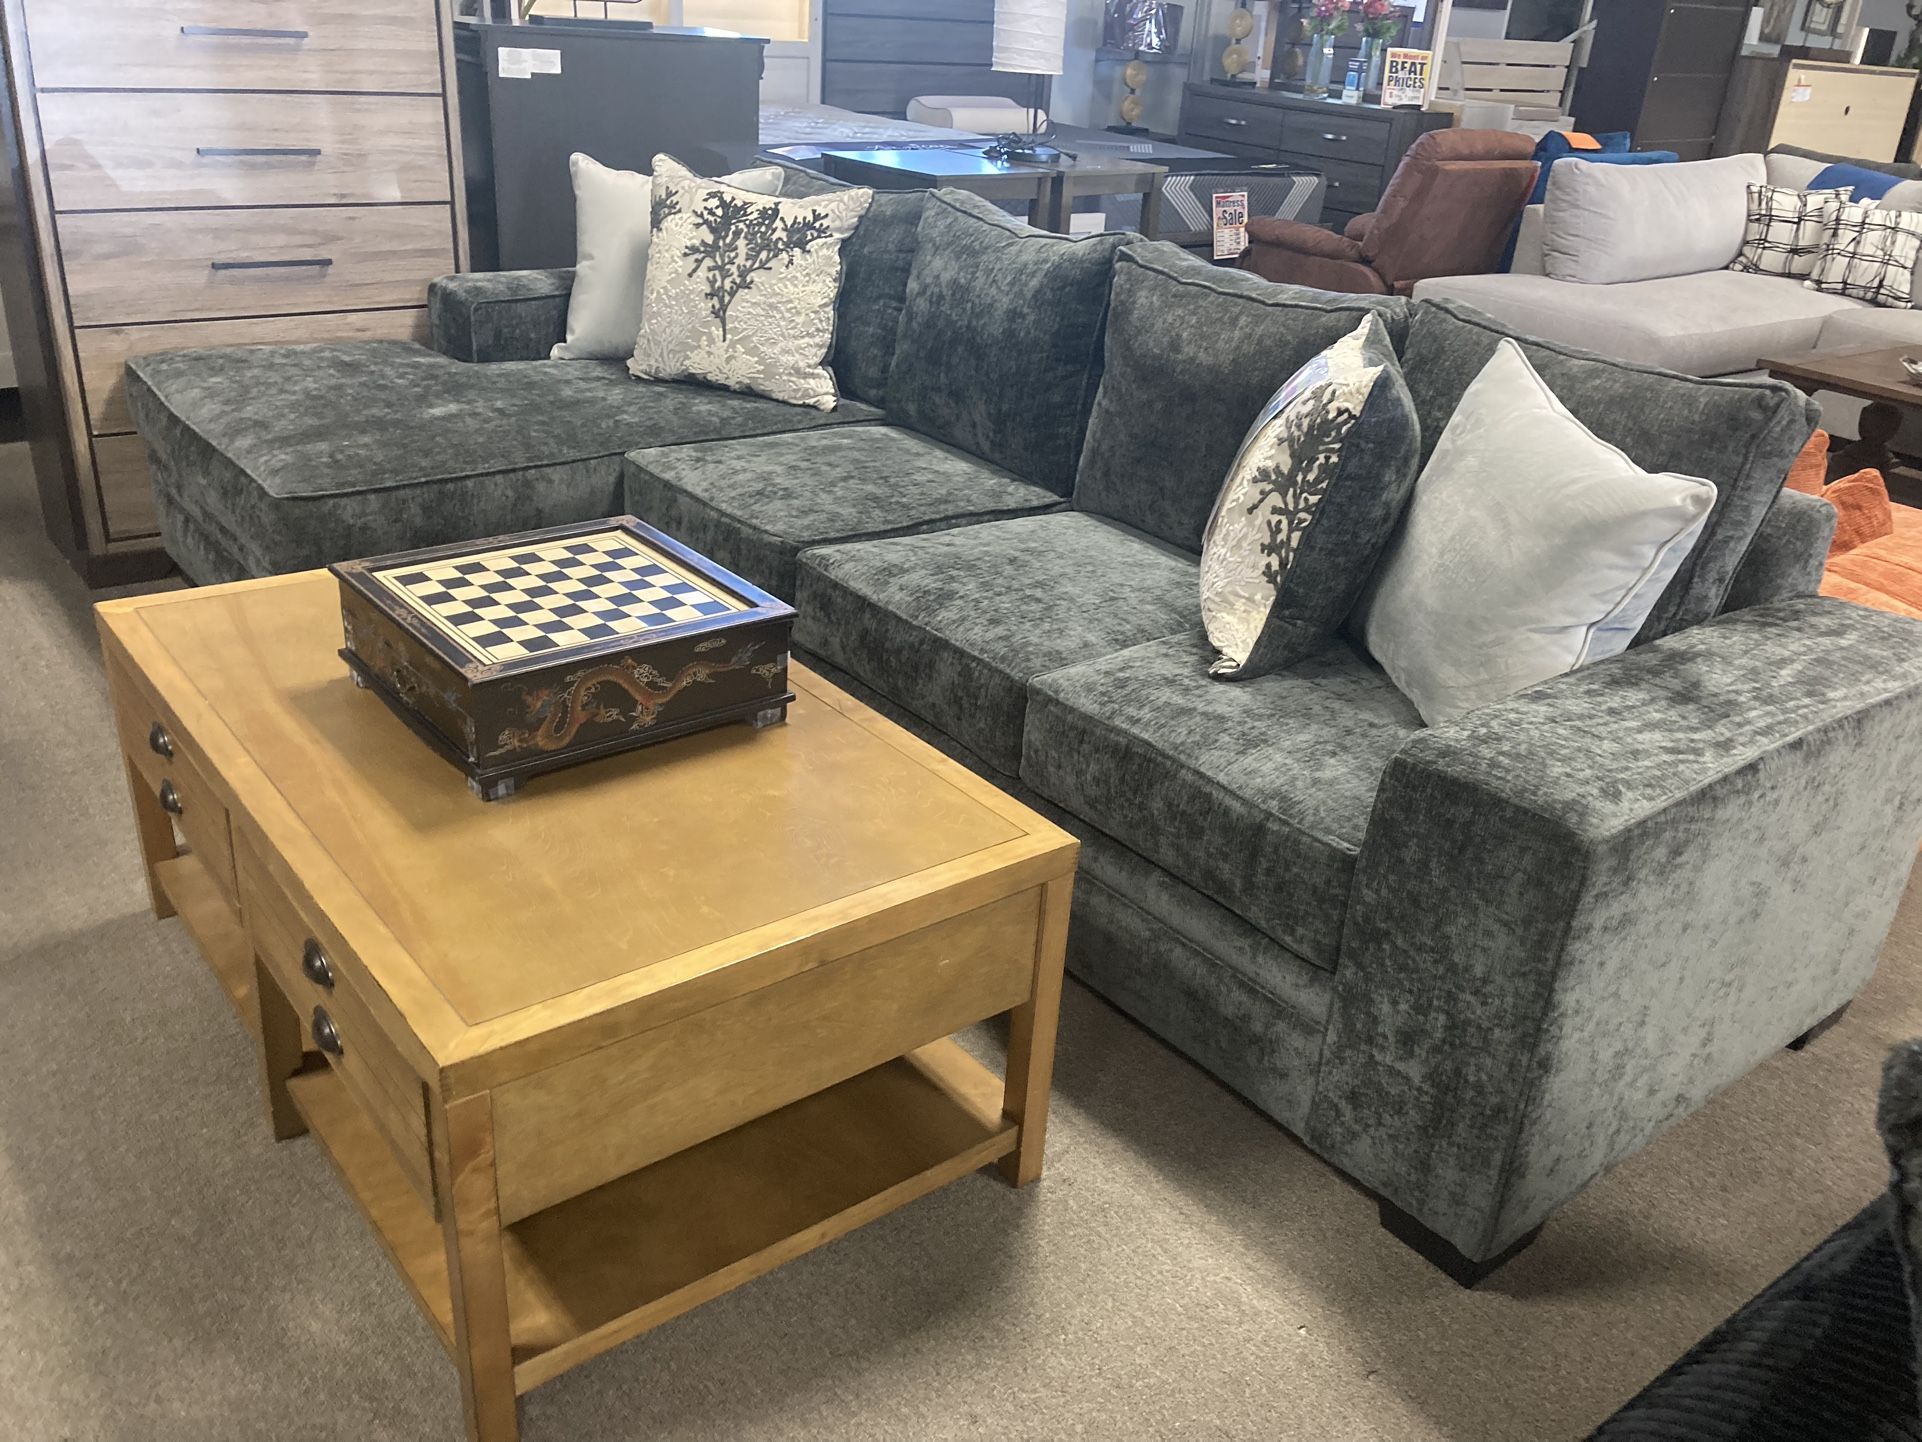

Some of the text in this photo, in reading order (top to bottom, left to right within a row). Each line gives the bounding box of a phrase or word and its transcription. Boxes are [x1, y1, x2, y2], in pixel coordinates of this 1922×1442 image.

[1389, 60, 1427, 76] BEAT
[1387, 75, 1425, 89] PRICES
[1222, 208, 1244, 226] Sale
